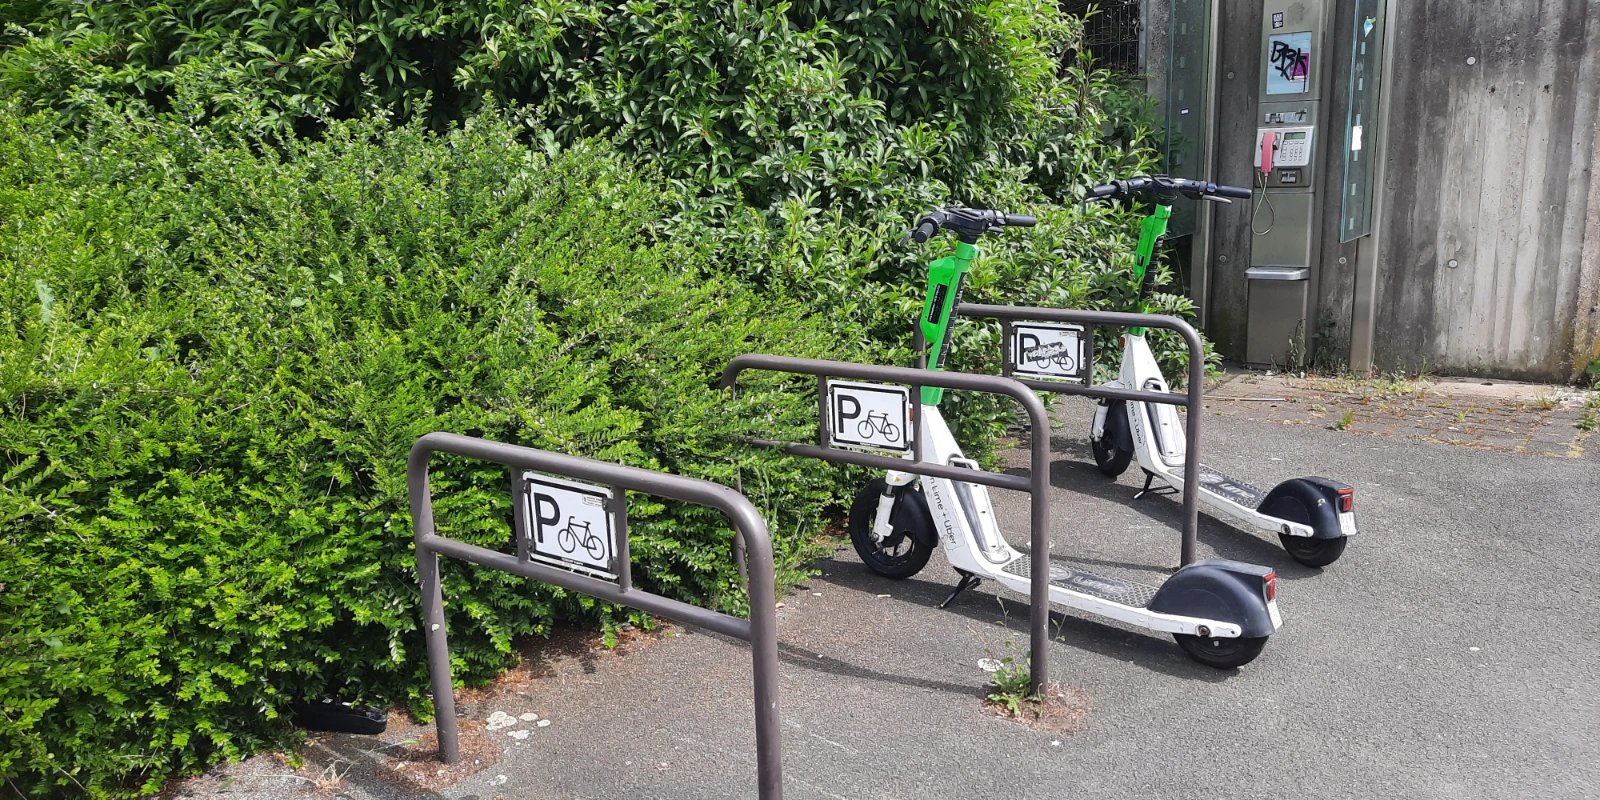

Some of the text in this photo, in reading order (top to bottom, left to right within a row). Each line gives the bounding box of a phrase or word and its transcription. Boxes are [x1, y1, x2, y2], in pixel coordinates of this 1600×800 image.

[1020, 333, 1040, 365] P
[837, 394, 861, 433] P
[533, 492, 560, 544] P
[943, 520, 957, 545] Uber
